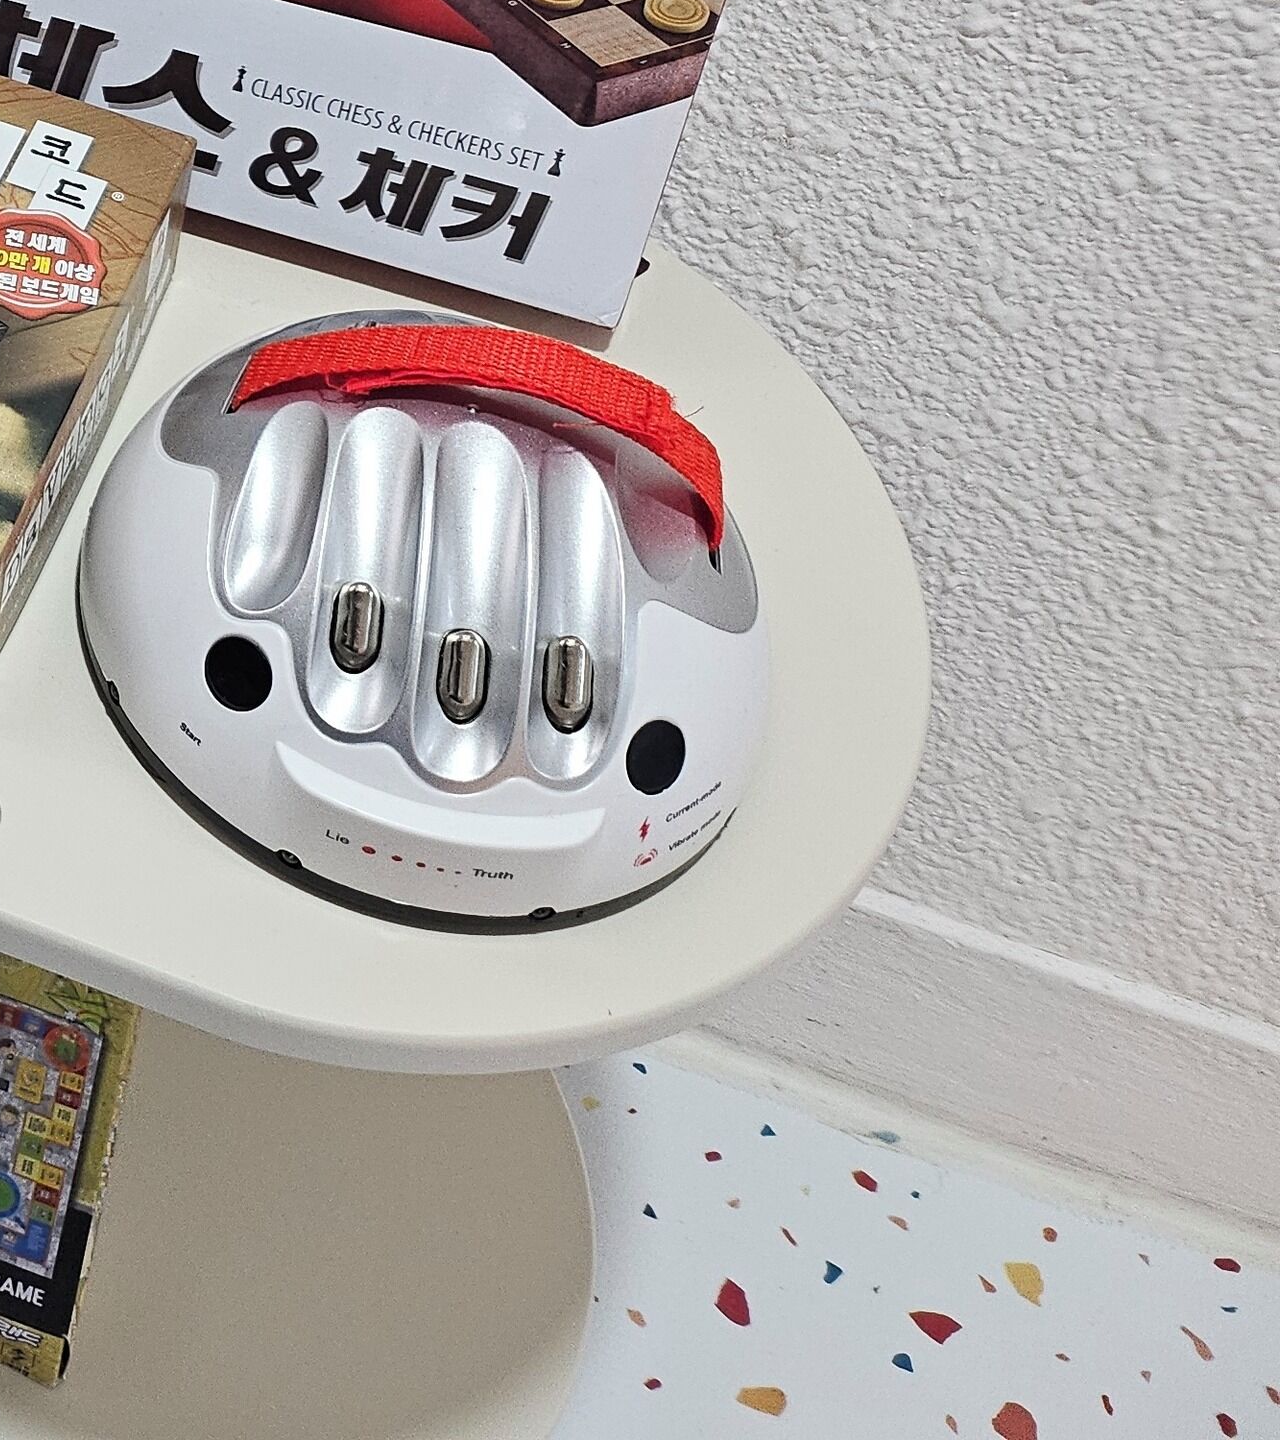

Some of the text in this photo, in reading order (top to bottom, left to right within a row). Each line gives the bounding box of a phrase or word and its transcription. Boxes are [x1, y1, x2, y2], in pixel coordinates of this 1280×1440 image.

[250, 77, 546, 172] CLASSIC CHESS & CHECKERS SET
[30, 134, 88, 211] 코드
[247, 126, 324, 208] &
[339, 145, 552, 263] 체커
[4, 228, 68, 255] 전 세계
[31, 254, 52, 275] 개
[54, 259, 96, 282] 이상
[20, 275, 100, 306] 보드게임
[178, 721, 202, 747] Start
[668, 828, 699, 851] Vibrate
[472, 866, 515, 881] Truth
